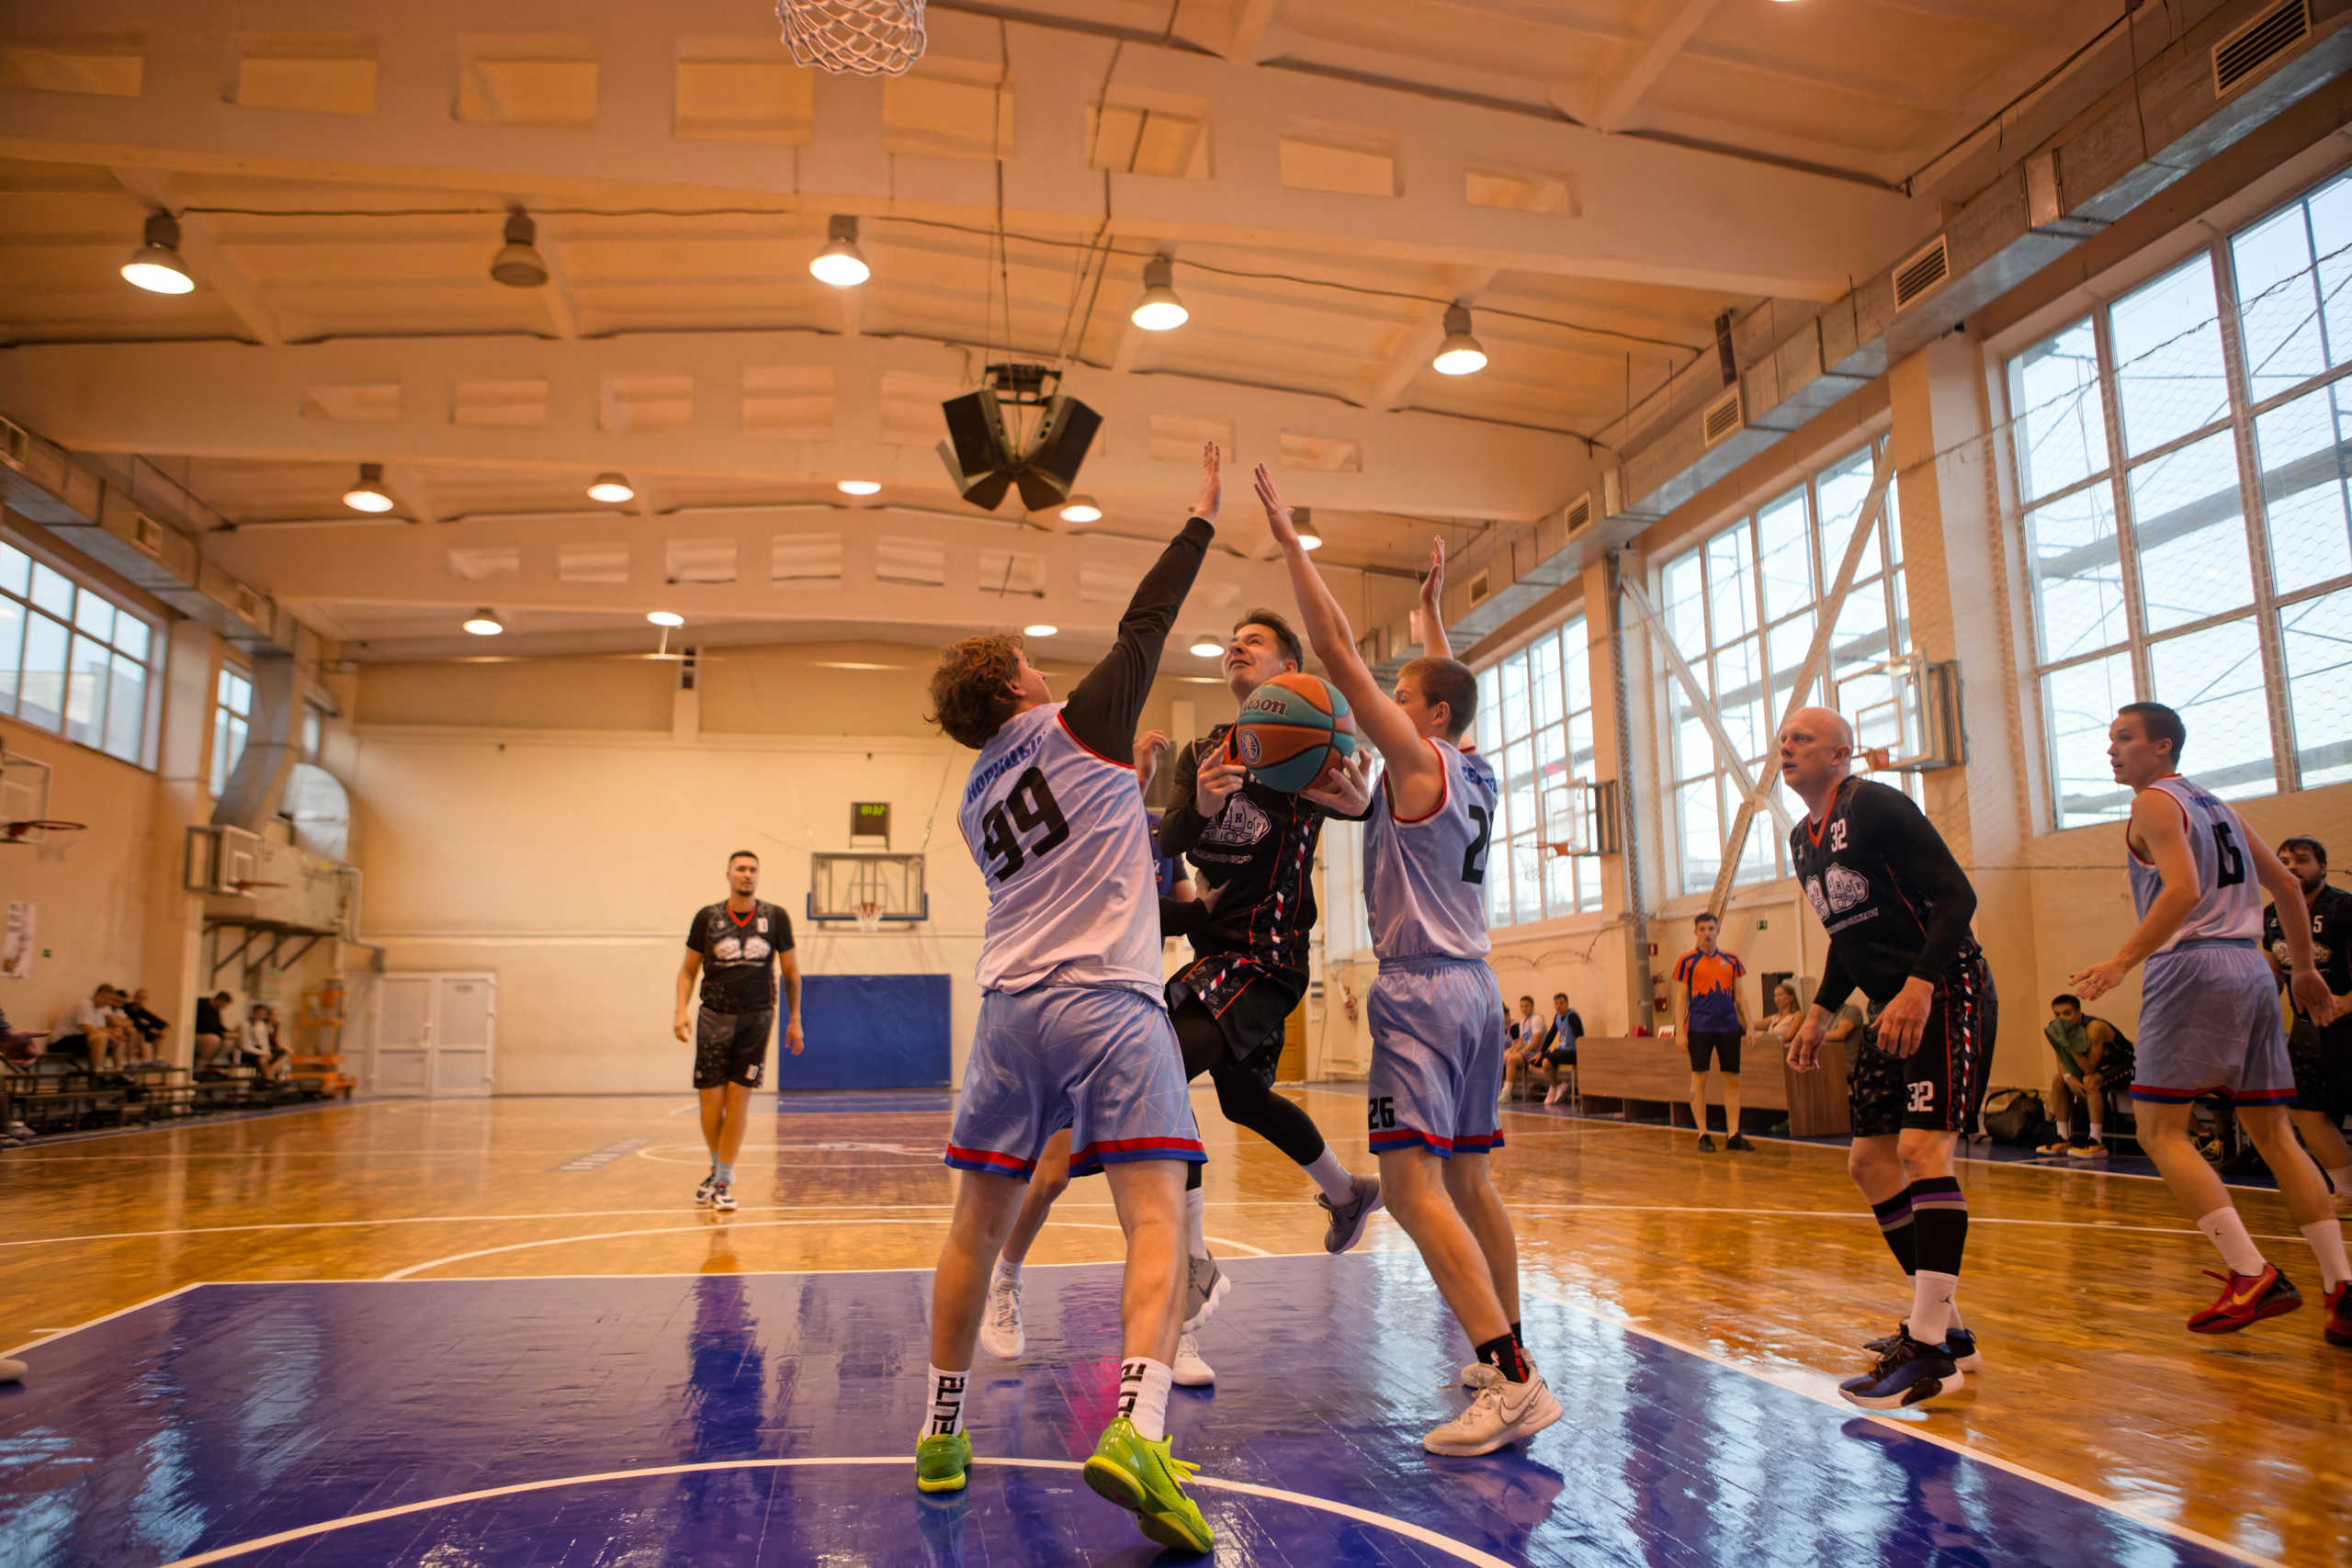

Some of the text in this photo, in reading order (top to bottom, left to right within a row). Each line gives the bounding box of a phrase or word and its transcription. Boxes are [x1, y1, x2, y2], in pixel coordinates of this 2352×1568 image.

[1244, 692, 1287, 716] ilson
[981, 766, 1069, 883] 99
[1830, 818, 1848, 853] 32
[1461, 804, 1494, 885] 2
[1906, 1080, 1935, 1112] 32
[1368, 1097, 1396, 1130] 26
